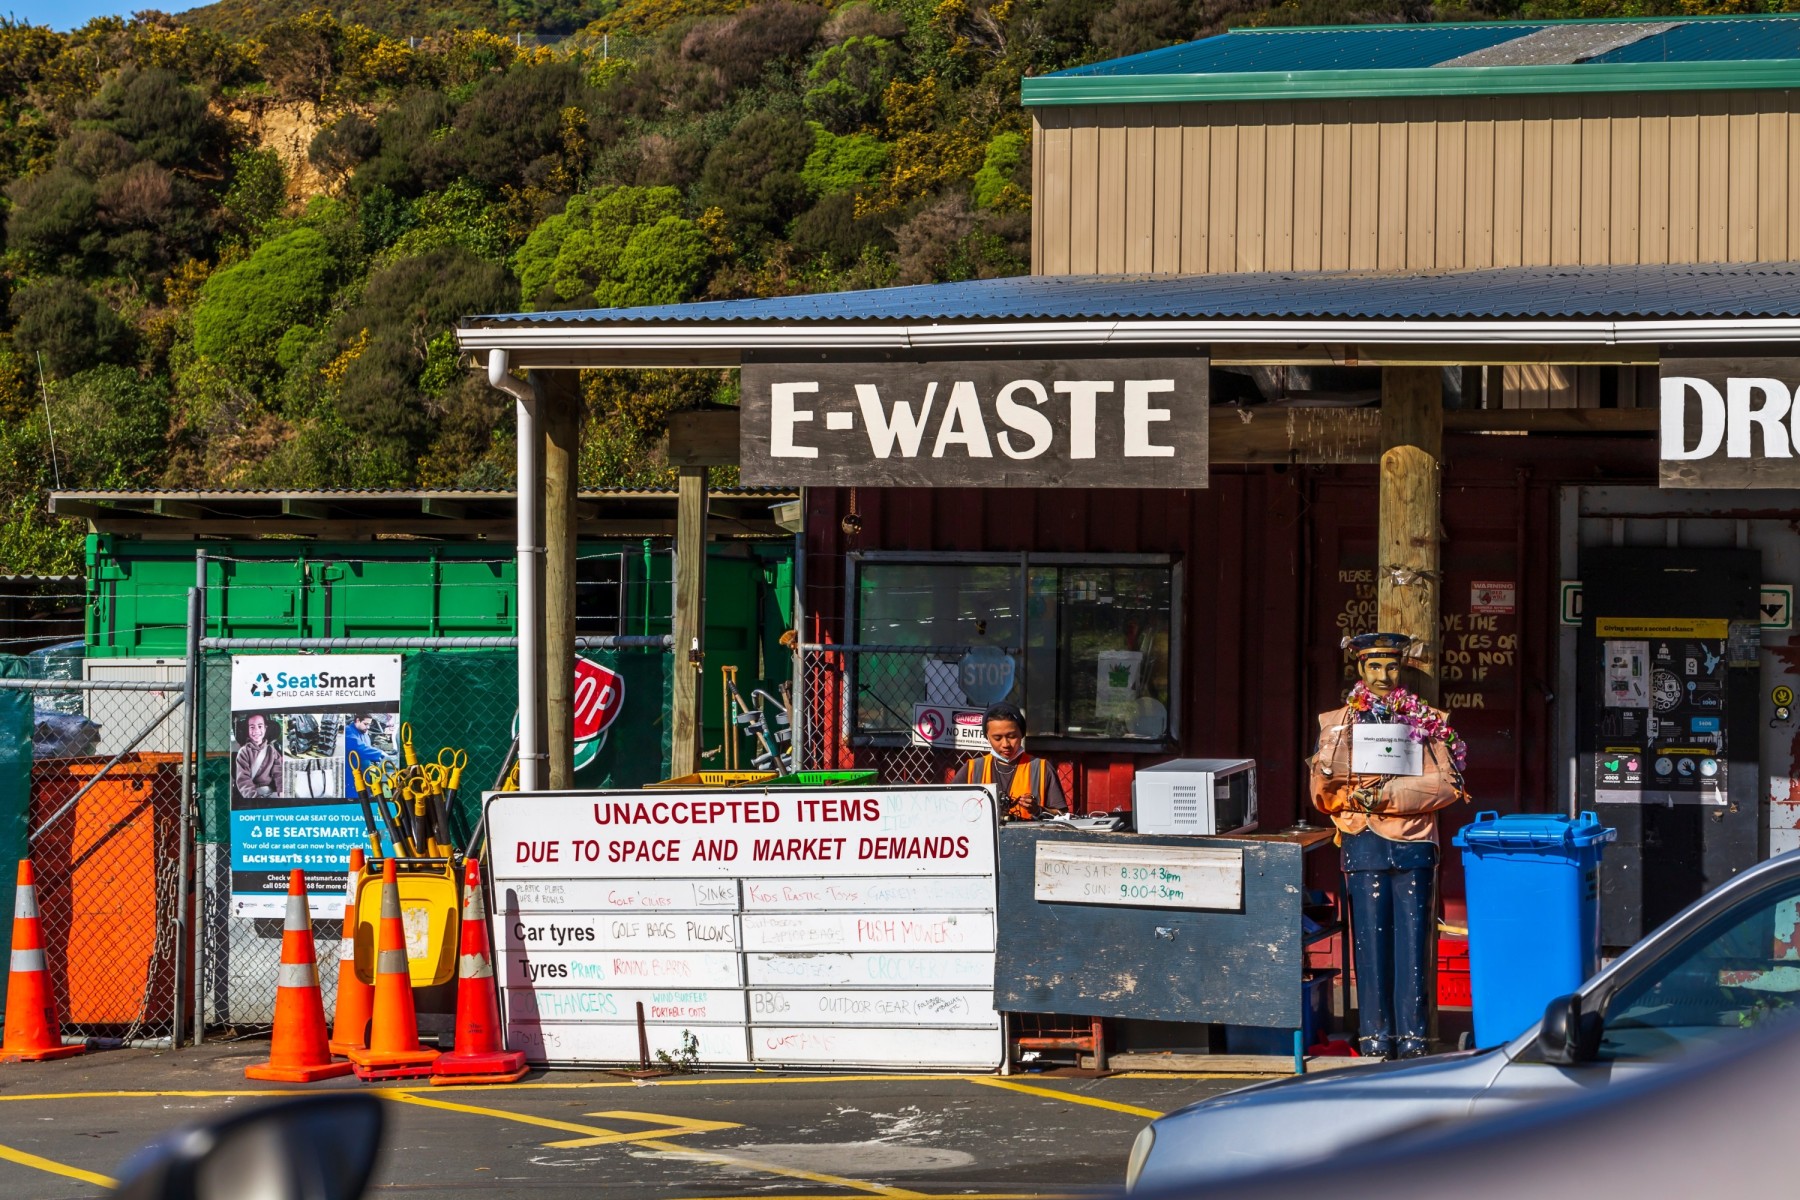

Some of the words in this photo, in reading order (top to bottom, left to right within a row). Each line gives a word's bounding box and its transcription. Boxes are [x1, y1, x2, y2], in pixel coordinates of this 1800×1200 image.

[771, 379, 1175, 460] E-WASTE
[1661, 377, 1800, 460] DR
[1339, 570, 1374, 582] PLEASE
[1345, 600, 1378, 616] GOO
[1336, 613, 1378, 628] STAF
[1469, 614, 1498, 631] THE
[1603, 624, 1624, 632] Giving
[1459, 634, 1491, 650] YES
[1497, 636, 1517, 651] OR
[1446, 651, 1471, 664] DO
[1479, 651, 1515, 667] NOT
[276, 671, 376, 689] SeatSmart
[963, 662, 1012, 687] STOP
[1473, 667, 1488, 679] IF
[335, 689, 376, 697] RECYCLING
[575, 671, 616, 726] OP
[1445, 693, 1484, 709] YOUR
[946, 728, 959, 736] NO
[239, 814, 262, 822] DON'T
[262, 814, 274, 822] LET
[275, 814, 295, 822] YOUR
[295, 814, 310, 822] CAR
[310, 814, 328, 822] SEAT
[328, 814, 341, 822] GO
[341, 814, 351, 822] TO
[594, 801, 780, 825] UNACCEPTED
[797, 799, 880, 823] ITEMS
[265, 827, 281, 838] BE
[283, 826, 359, 838] SEATSMART!
[242, 842, 257, 850] Your
[258, 842, 269, 850] old
[336, 842, 364, 852] recycled
[517, 841, 559, 863] DUE
[571, 840, 600, 862] TO
[608, 839, 680, 863] SPACE
[691, 839, 739, 862] AND
[753, 838, 847, 861] MARKET
[858, 836, 969, 860] DEMANDS
[242, 855, 268, 863] EACH
[269, 855, 294, 863] SEAT
[294, 855, 303, 863] IS
[304, 855, 323, 864] $12
[324, 855, 338, 863] TO
[1043, 861, 1070, 876] MON
[267, 873, 286, 881] Check
[514, 922, 545, 942] Car
[550, 923, 596, 946] tyres
[611, 920, 640, 940] GOLF
[646, 922, 676, 940] BAGS
[686, 920, 735, 943] PILLOWS
[857, 918, 897, 943] PUSH
[518, 958, 568, 983] Tyres
[818, 995, 872, 1015] OUTDOOR
